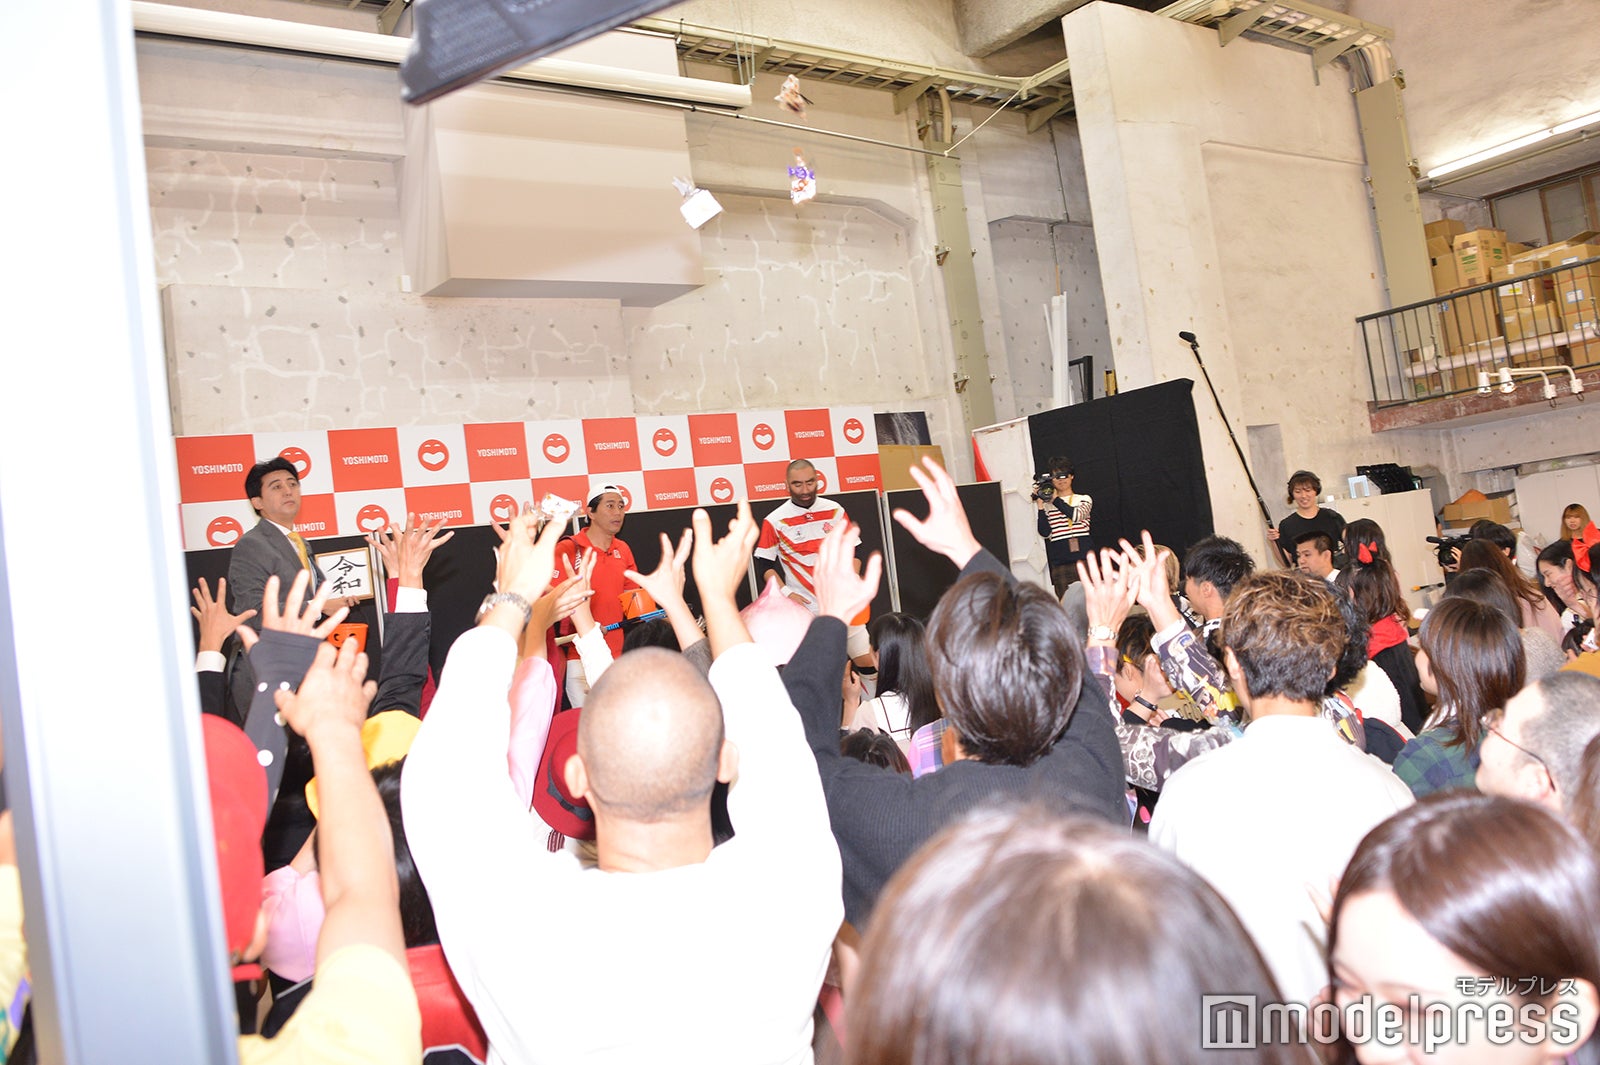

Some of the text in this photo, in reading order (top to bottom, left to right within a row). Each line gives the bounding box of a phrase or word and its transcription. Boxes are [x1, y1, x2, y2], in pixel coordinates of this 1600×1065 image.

[698, 435, 732, 445] YOSHIMOTO
[794, 430, 825, 439] YOSHIMOTO
[593, 441, 630, 451] YOSHIMOTO
[476, 447, 518, 457] YOSHIMOTO
[342, 454, 389, 465] YOSHIMOTO
[192, 463, 244, 475] YOSHIMOTO
[845, 474, 875, 484] YOSHIMOTO
[754, 482, 786, 493] YOSHIMOTO
[654, 490, 689, 501] YOSHIMOTO
[418, 509, 463, 521] YOSHIMOTO
[327, 556, 367, 594] 令和
